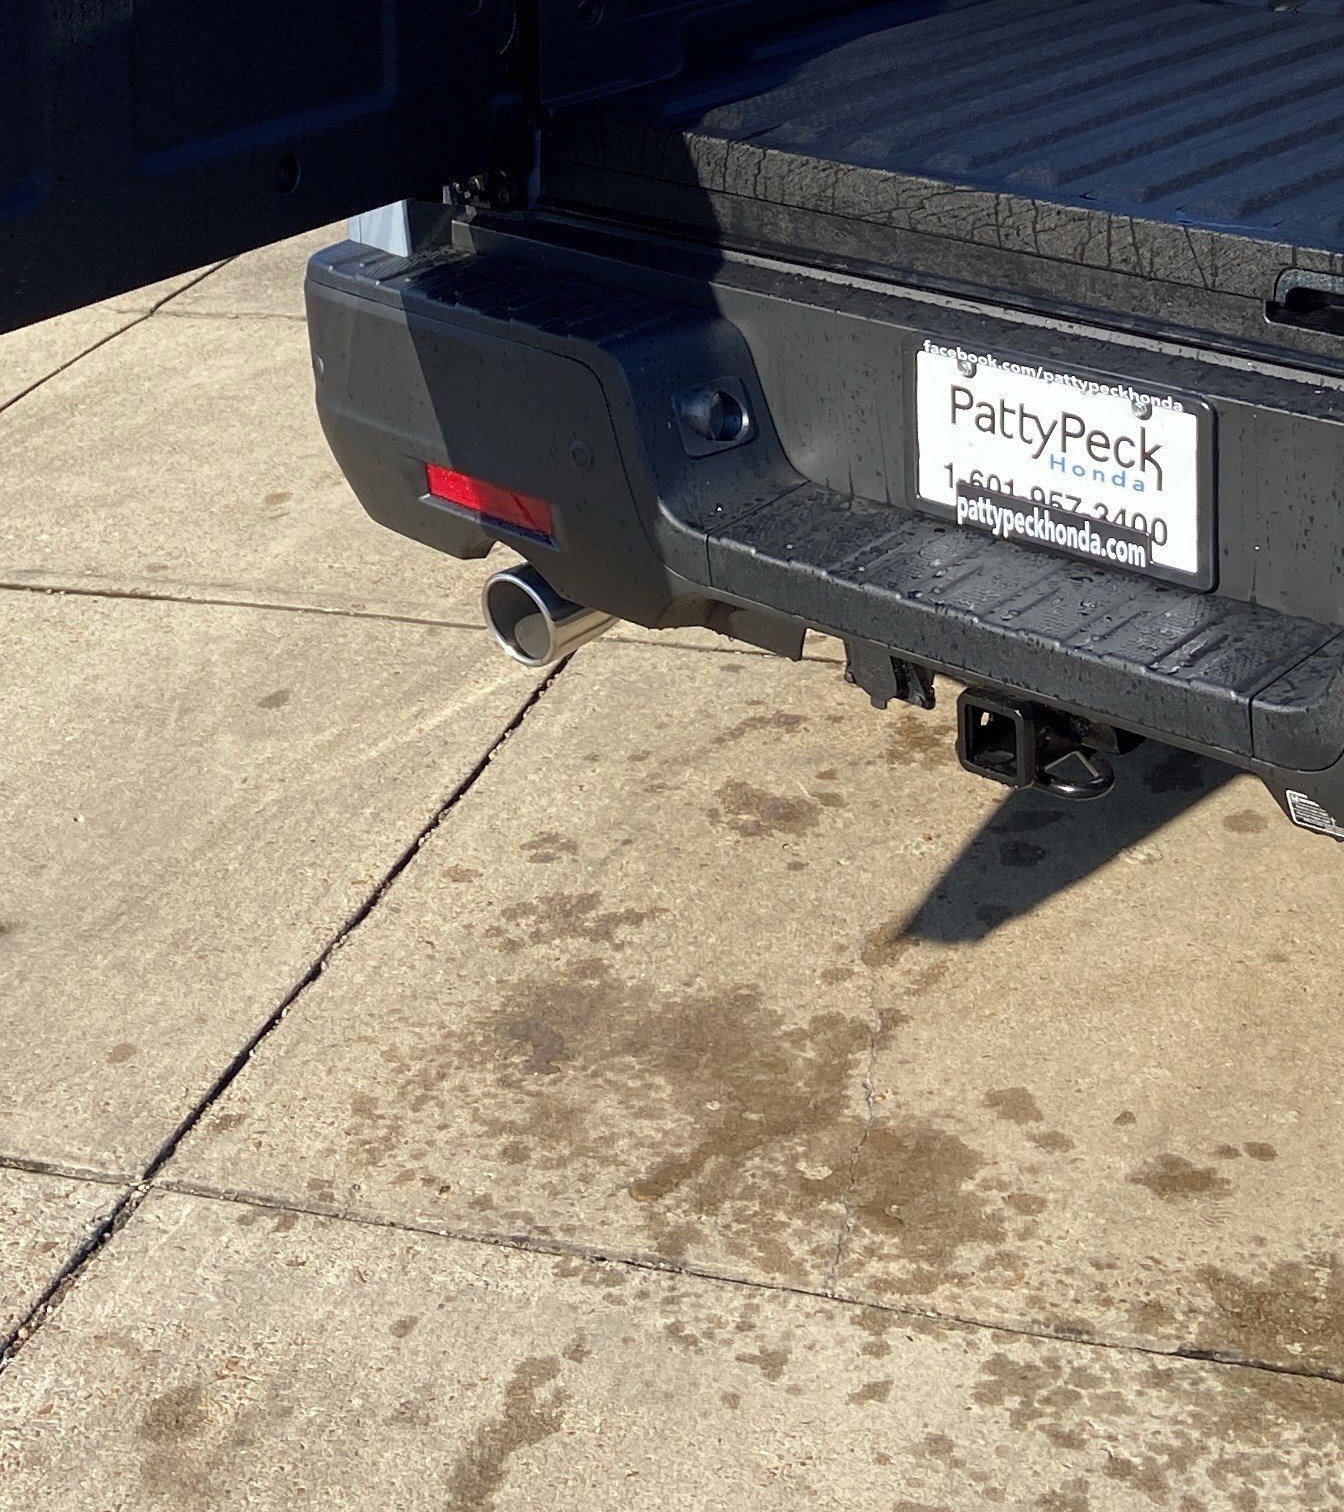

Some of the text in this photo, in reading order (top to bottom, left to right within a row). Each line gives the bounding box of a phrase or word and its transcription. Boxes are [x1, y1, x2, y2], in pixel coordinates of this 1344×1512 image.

[923, 339, 1184, 412] facebook.com/pattypeckhonda
[1049, 453, 1146, 493] Honda
[956, 495, 1147, 569] pattypeckhonda.com
